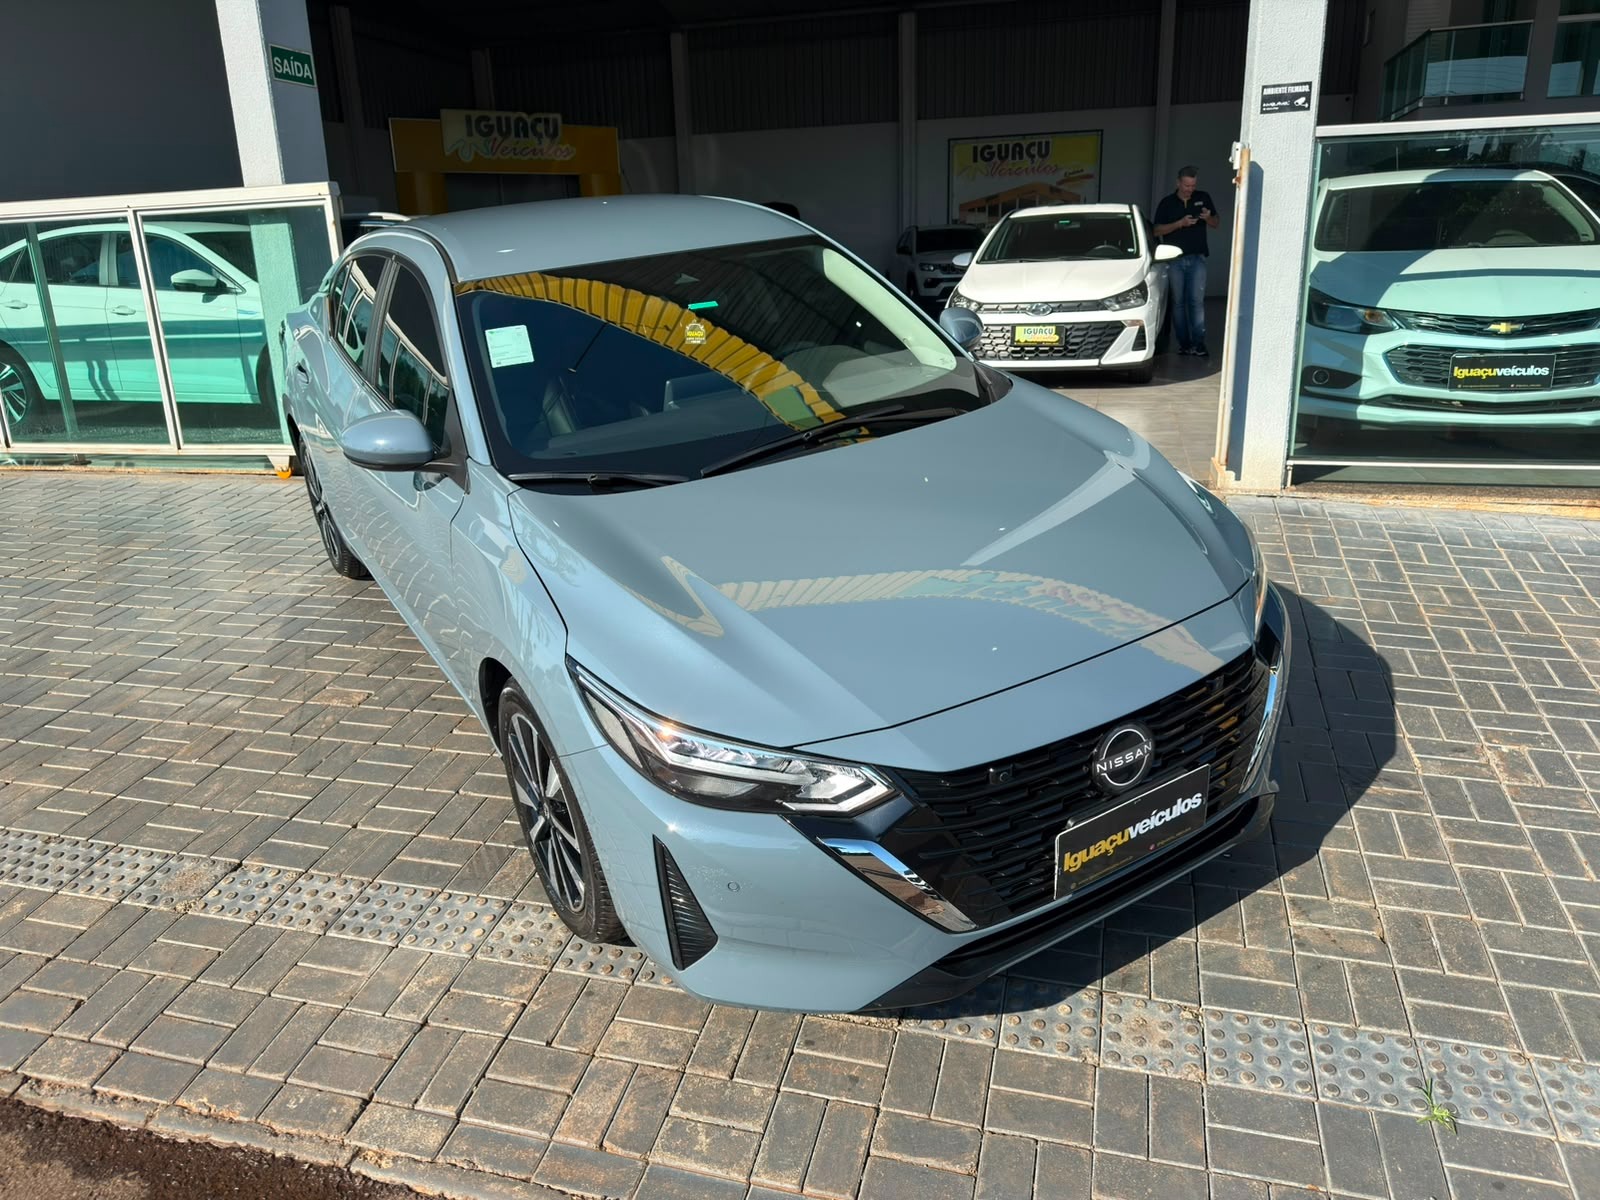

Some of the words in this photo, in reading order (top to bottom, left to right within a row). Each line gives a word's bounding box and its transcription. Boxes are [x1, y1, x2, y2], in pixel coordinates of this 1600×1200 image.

[273, 56, 313, 80] SAÍDA
[464, 114, 560, 145] IGUAÇU
[972, 140, 1051, 164] IGUAÇU
[1453, 365, 1550, 380] Iguaçuveículos
[1096, 741, 1152, 773] NISSAN
[1063, 792, 1202, 872] Iguaçuveículos
